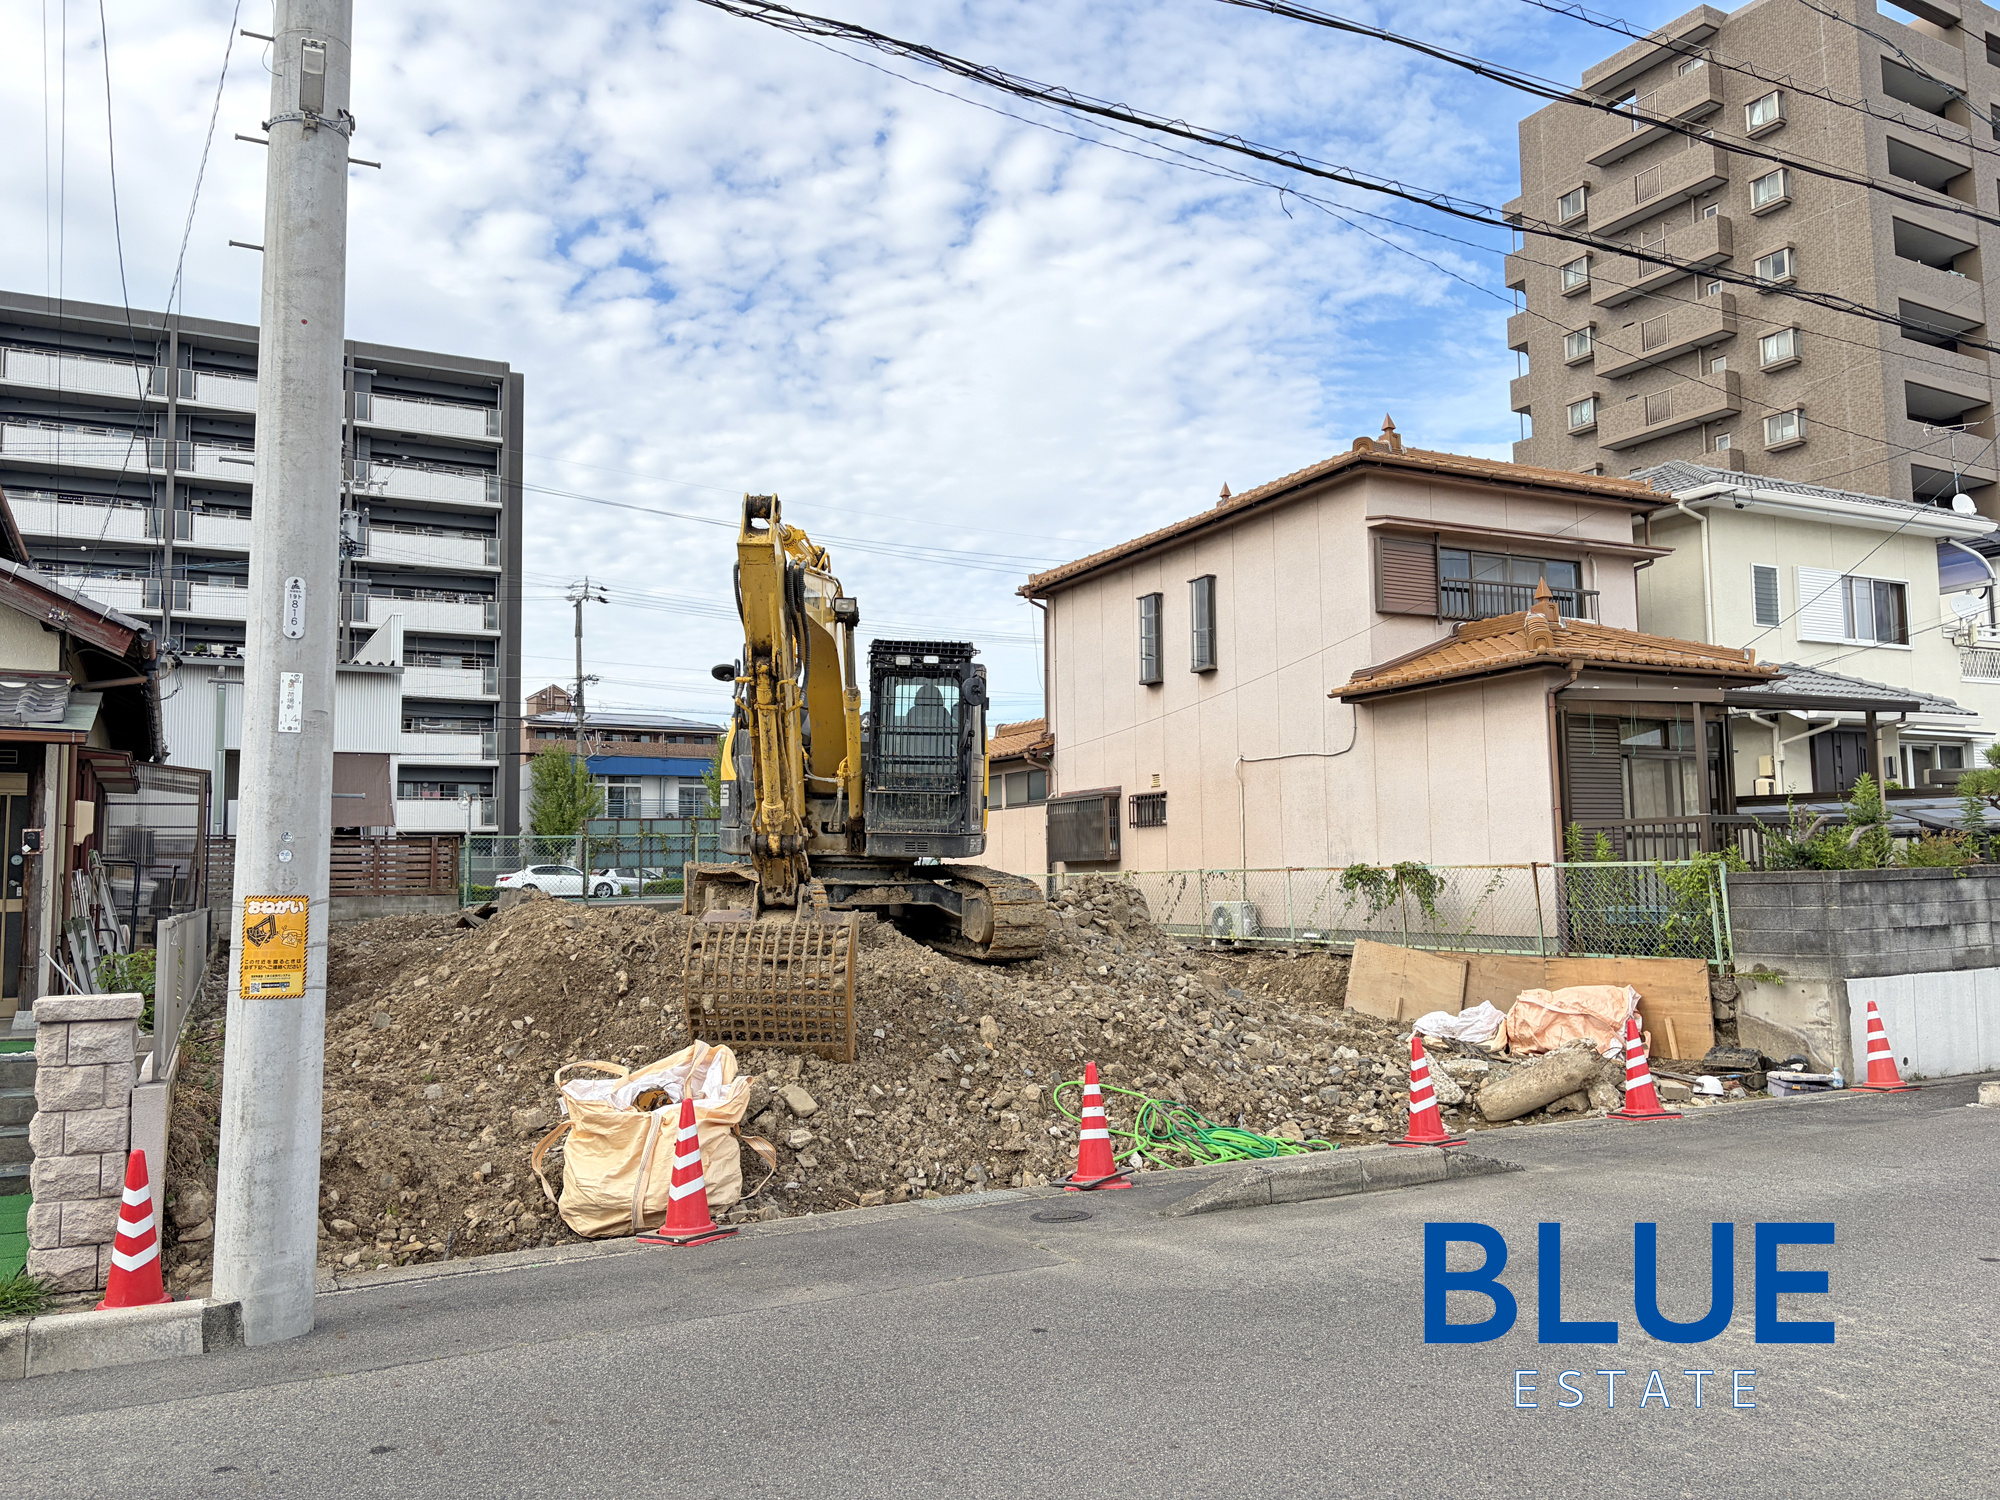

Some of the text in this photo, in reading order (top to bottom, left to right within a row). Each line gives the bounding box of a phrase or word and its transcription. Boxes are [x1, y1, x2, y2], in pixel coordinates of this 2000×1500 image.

[290, 600, 299, 626] 816
[247, 900, 304, 914] おねがい
